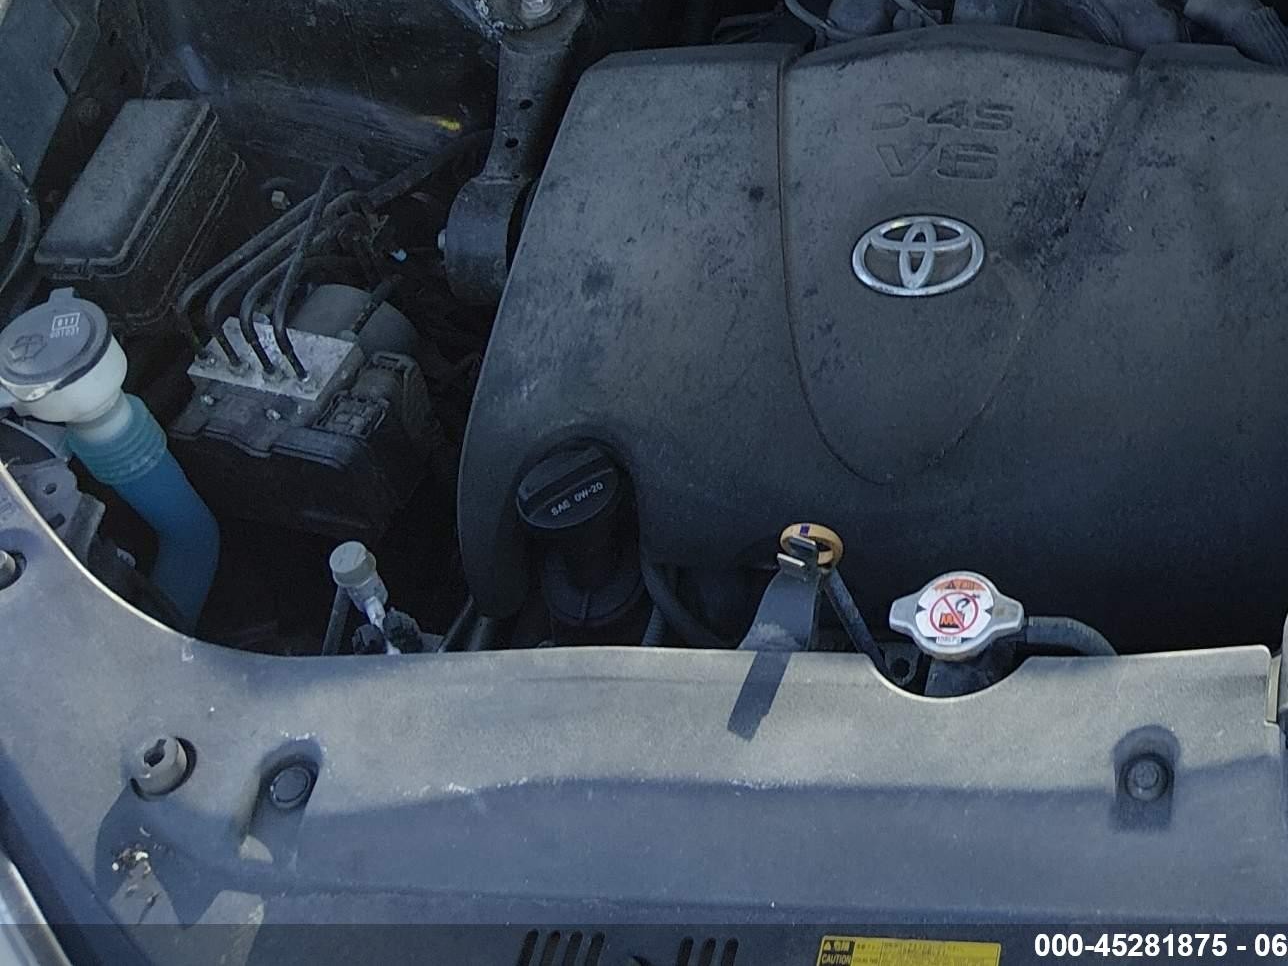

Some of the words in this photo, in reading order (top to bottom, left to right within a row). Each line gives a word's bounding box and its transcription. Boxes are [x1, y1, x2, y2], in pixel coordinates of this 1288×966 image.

[872, 100, 1014, 131] D-4S
[876, 143, 1000, 180] V6
[551, 498, 572, 517] SAE
[573, 481, 604, 503] 0W-20
[821, 952, 852, 965] CAUTION
